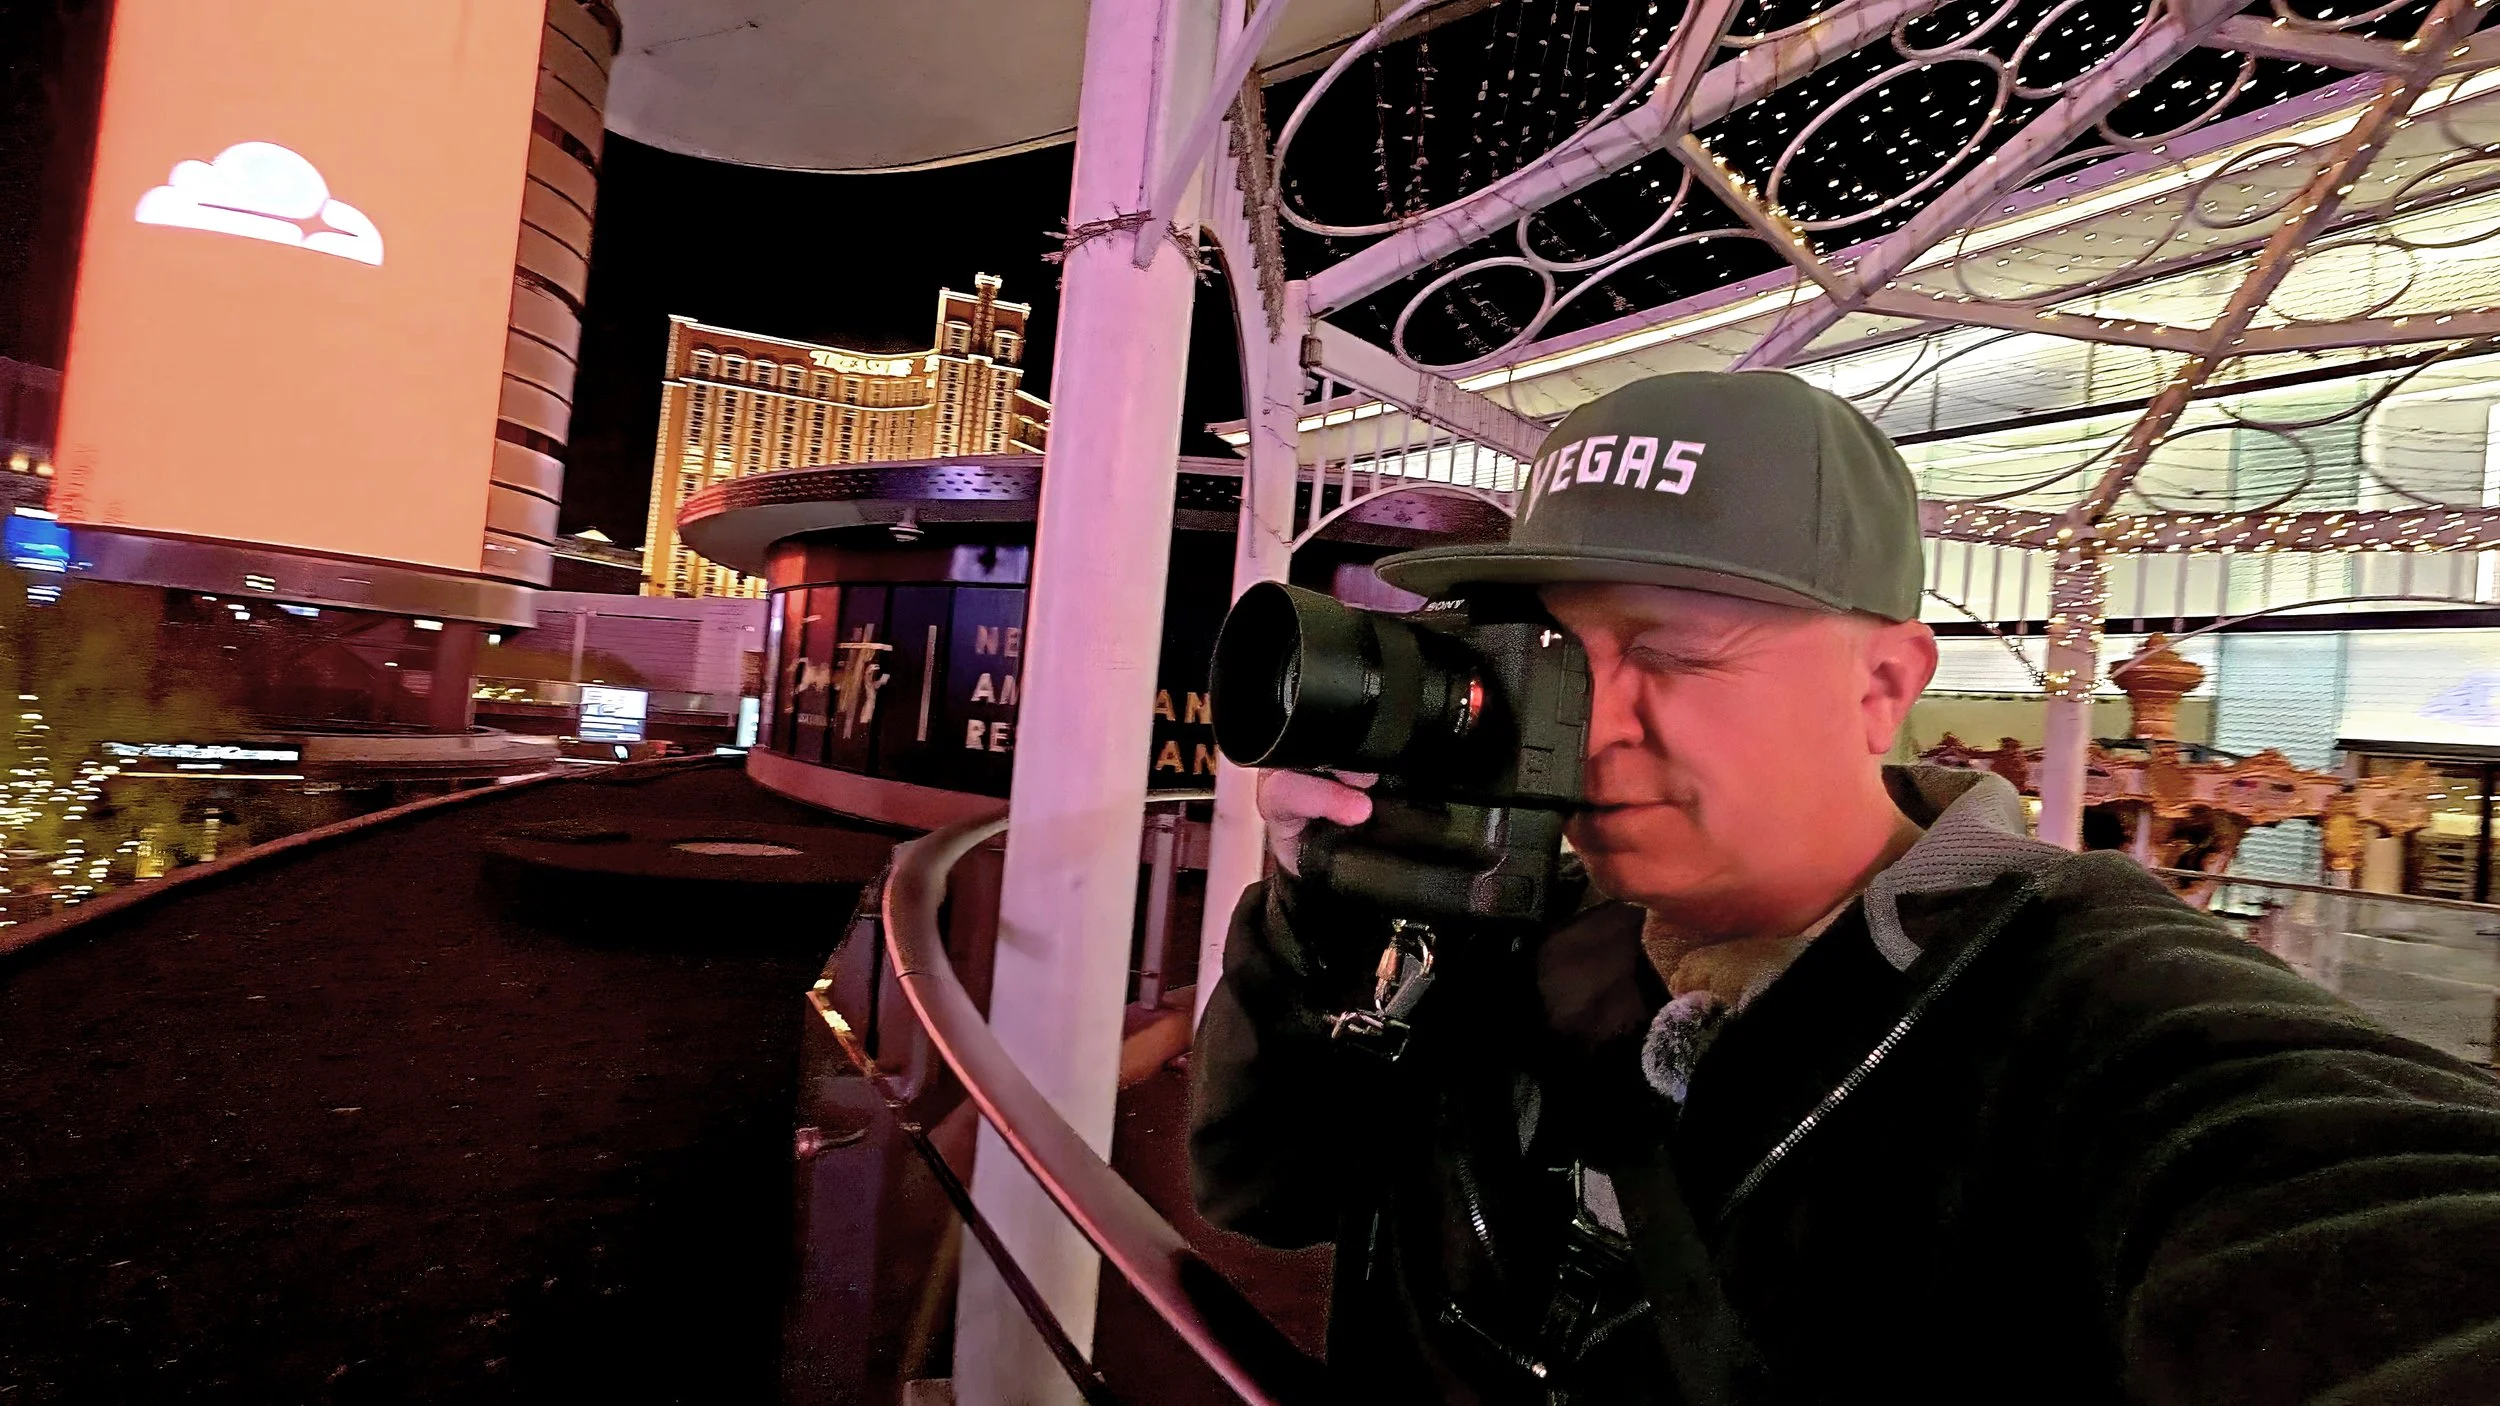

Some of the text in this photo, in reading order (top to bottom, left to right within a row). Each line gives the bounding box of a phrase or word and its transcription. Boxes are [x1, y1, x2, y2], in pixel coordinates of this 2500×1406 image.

[1524, 434, 1706, 526] VEGAS
[1424, 599, 1465, 611] SONY
[975, 625, 1021, 658] NE
[965, 719, 1014, 753] RE
